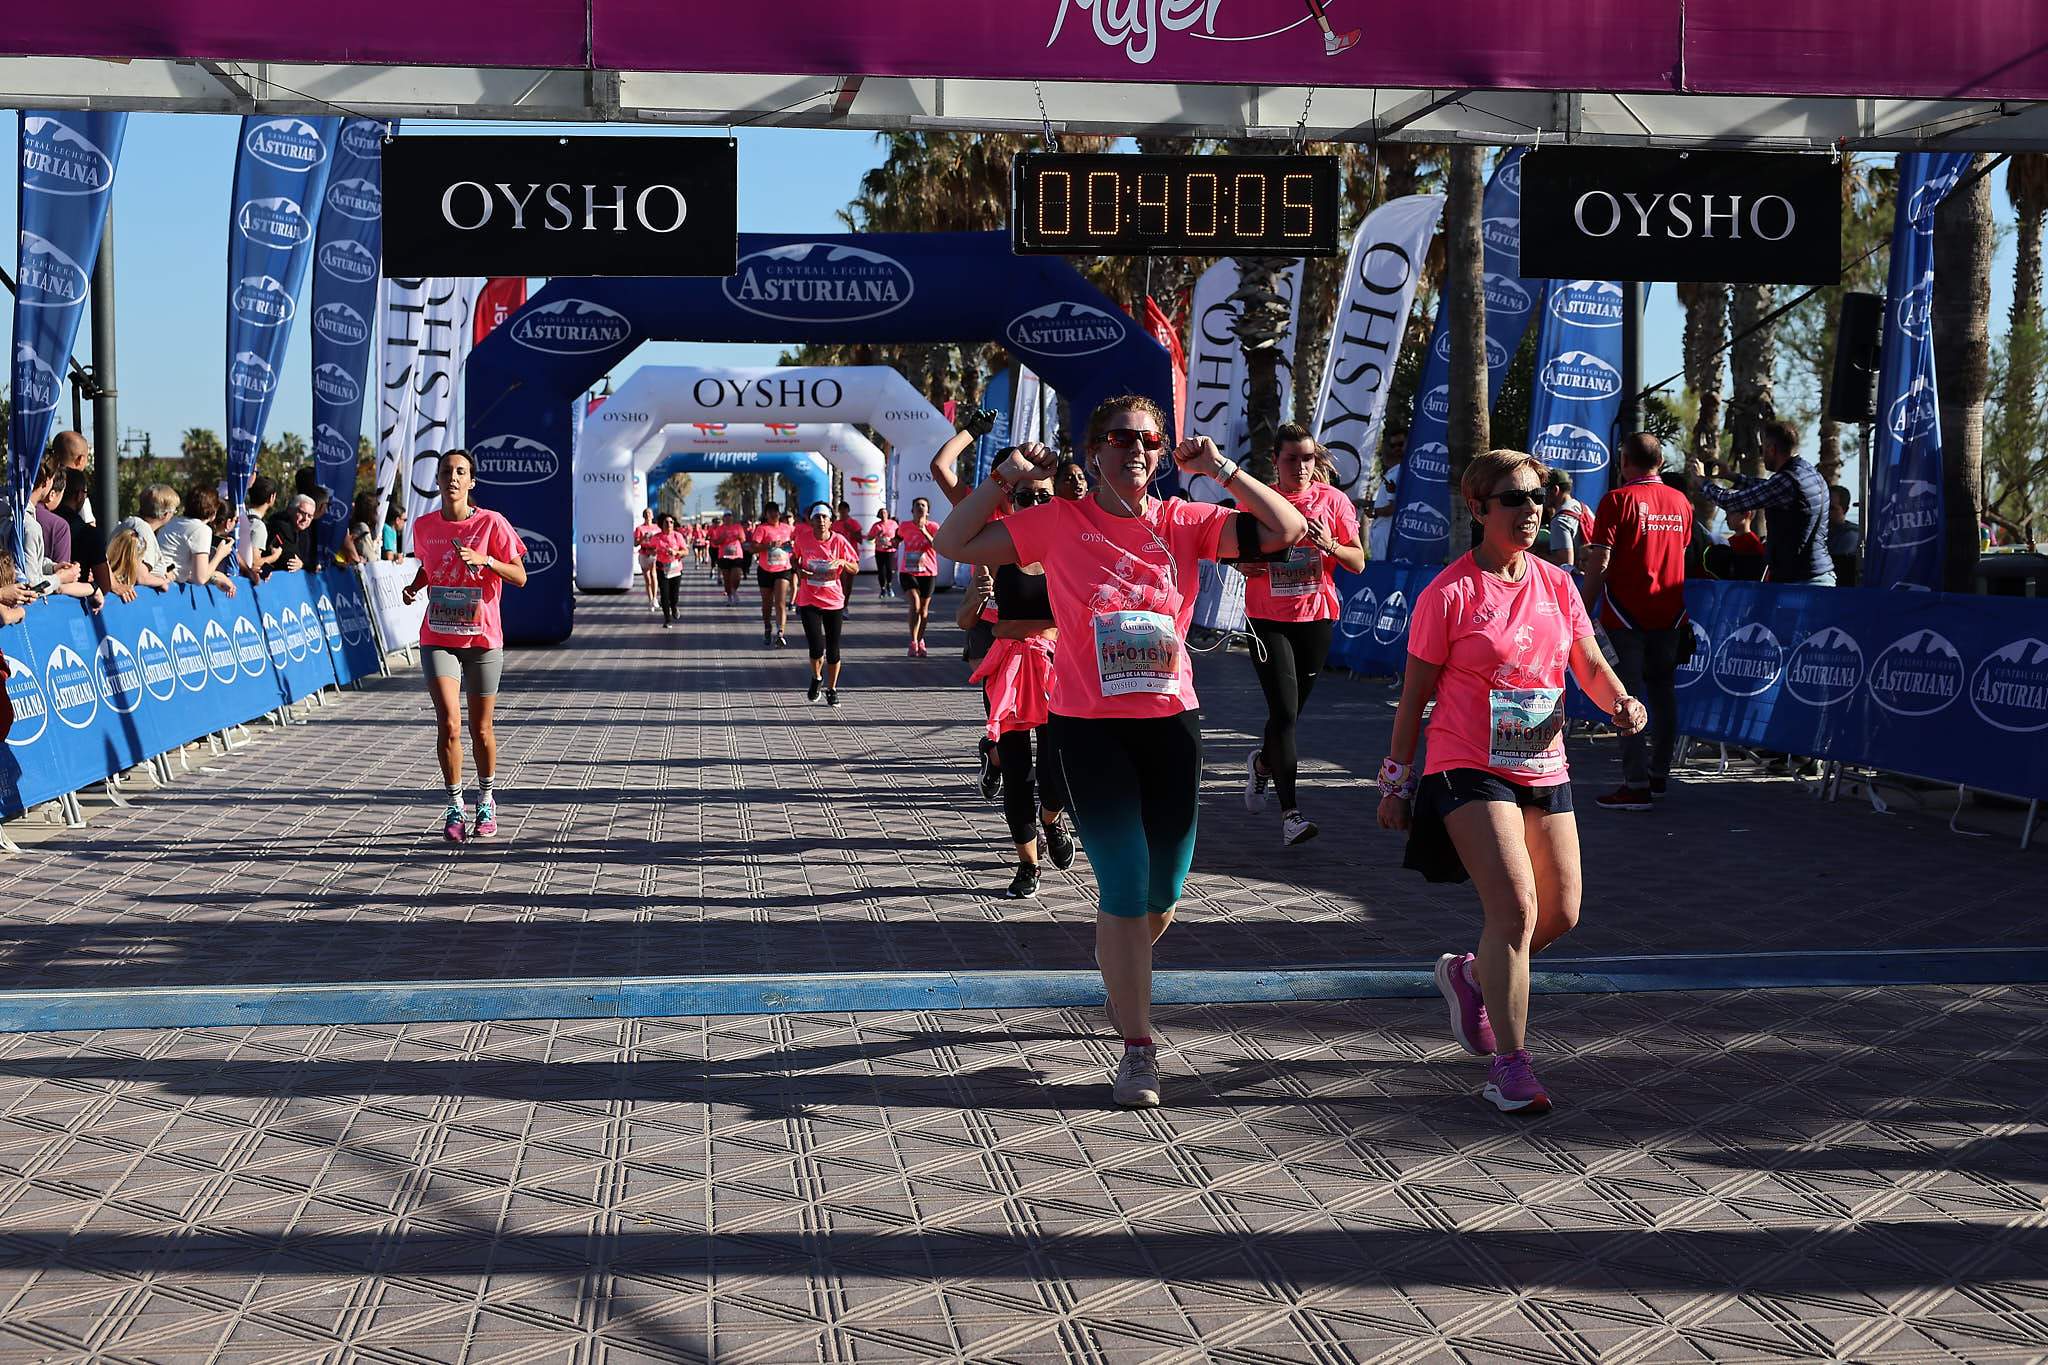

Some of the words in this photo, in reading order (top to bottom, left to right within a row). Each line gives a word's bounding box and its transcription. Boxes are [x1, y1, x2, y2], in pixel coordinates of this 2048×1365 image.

[54, 147, 98, 164] LECHERA
[441, 181, 687, 233] OYSHO
[1038, 171, 1313, 237] 00:40:05
[1574, 190, 1796, 241] OYSHO
[323, 249, 372, 276] ASTURIANA
[767, 265, 826, 275] CENTRAL
[832, 265, 894, 275] LECHERA
[737, 266, 901, 302] ASTURIANA
[317, 311, 363, 339] ASTURIANA
[518, 320, 622, 340] ASTURIANA
[1016, 323, 1119, 344] ASTURIANA
[693, 378, 842, 408] OYSHO
[603, 412, 649, 423] OYSHO
[885, 410, 930, 421] OYSHO
[583, 472, 625, 483] OYSHO
[1647, 523, 1672, 532] TONY
[582, 536, 625, 547] OYSHO
[1123, 622, 1156, 631] ASTURIANA
[1716, 647, 1776, 680] ASTURIANA
[1790, 653, 1855, 687] ASTURIANA
[99, 667, 140, 697] ASTURIANA
[1105, 673, 1126, 681] CARRERA
[1110, 680, 1138, 691] OYSHO
[1874, 659, 1954, 697] ASTURIANA
[52, 678, 96, 711] ASTURIANA
